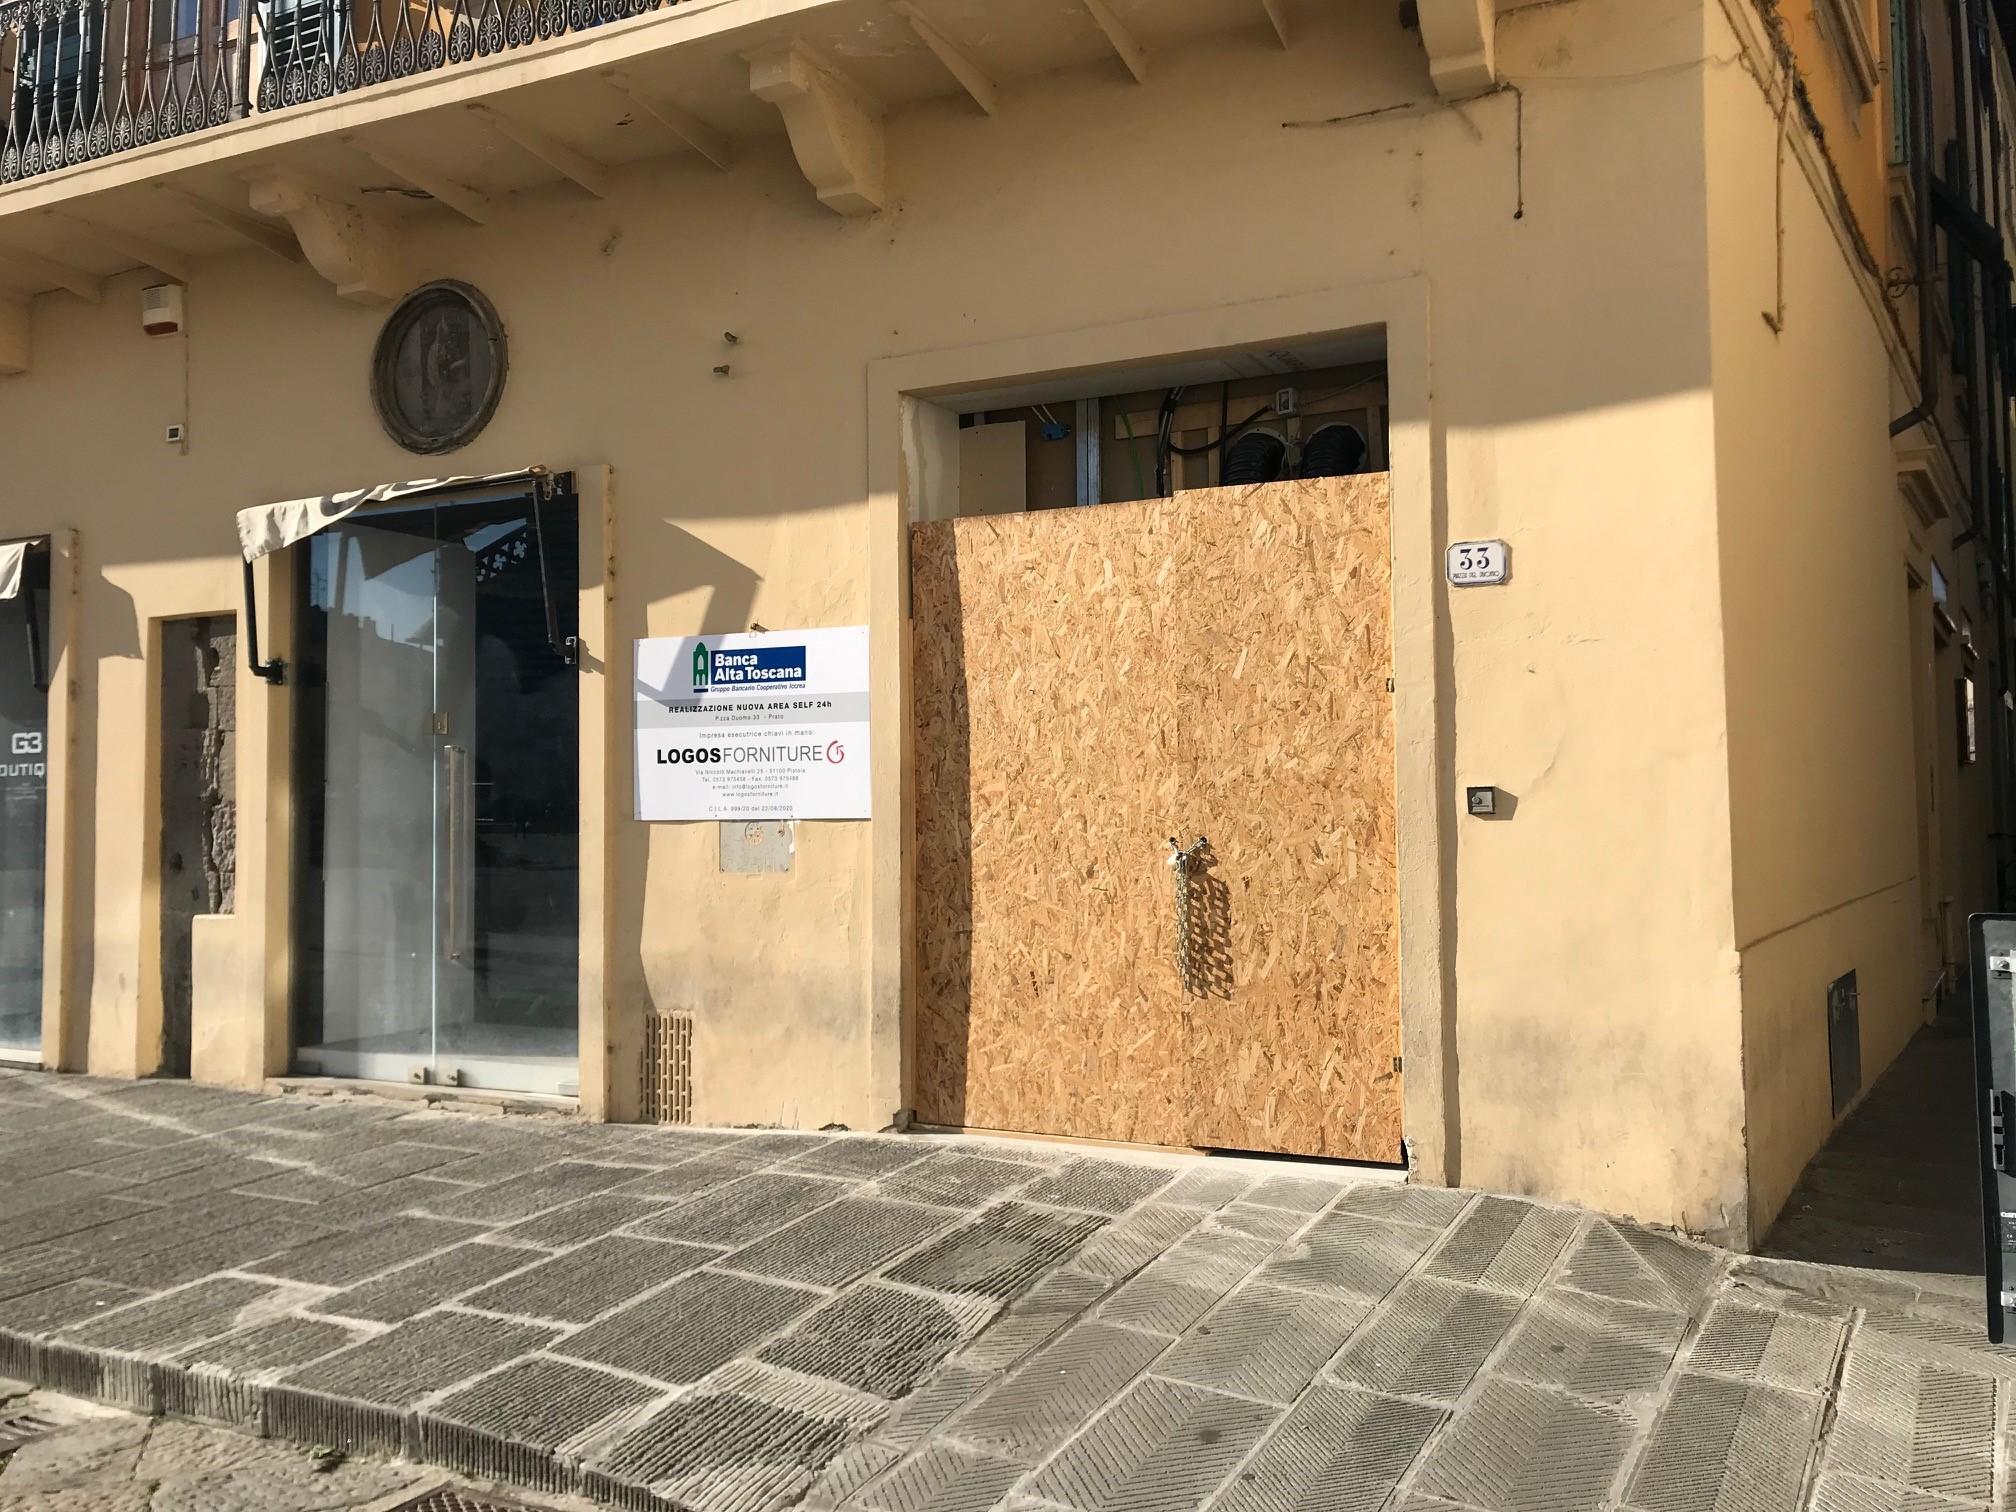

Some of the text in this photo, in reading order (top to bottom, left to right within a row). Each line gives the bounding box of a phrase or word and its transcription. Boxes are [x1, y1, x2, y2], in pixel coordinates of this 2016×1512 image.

[1460, 547, 1490, 570] 33
[715, 653, 758, 667] Banca
[714, 666, 802, 682] Alta Toscana
[756, 683, 788, 691] Cooperativo
[668, 700, 832, 713] REALIZZAZIONE NUOVA AREA SELF 24h
